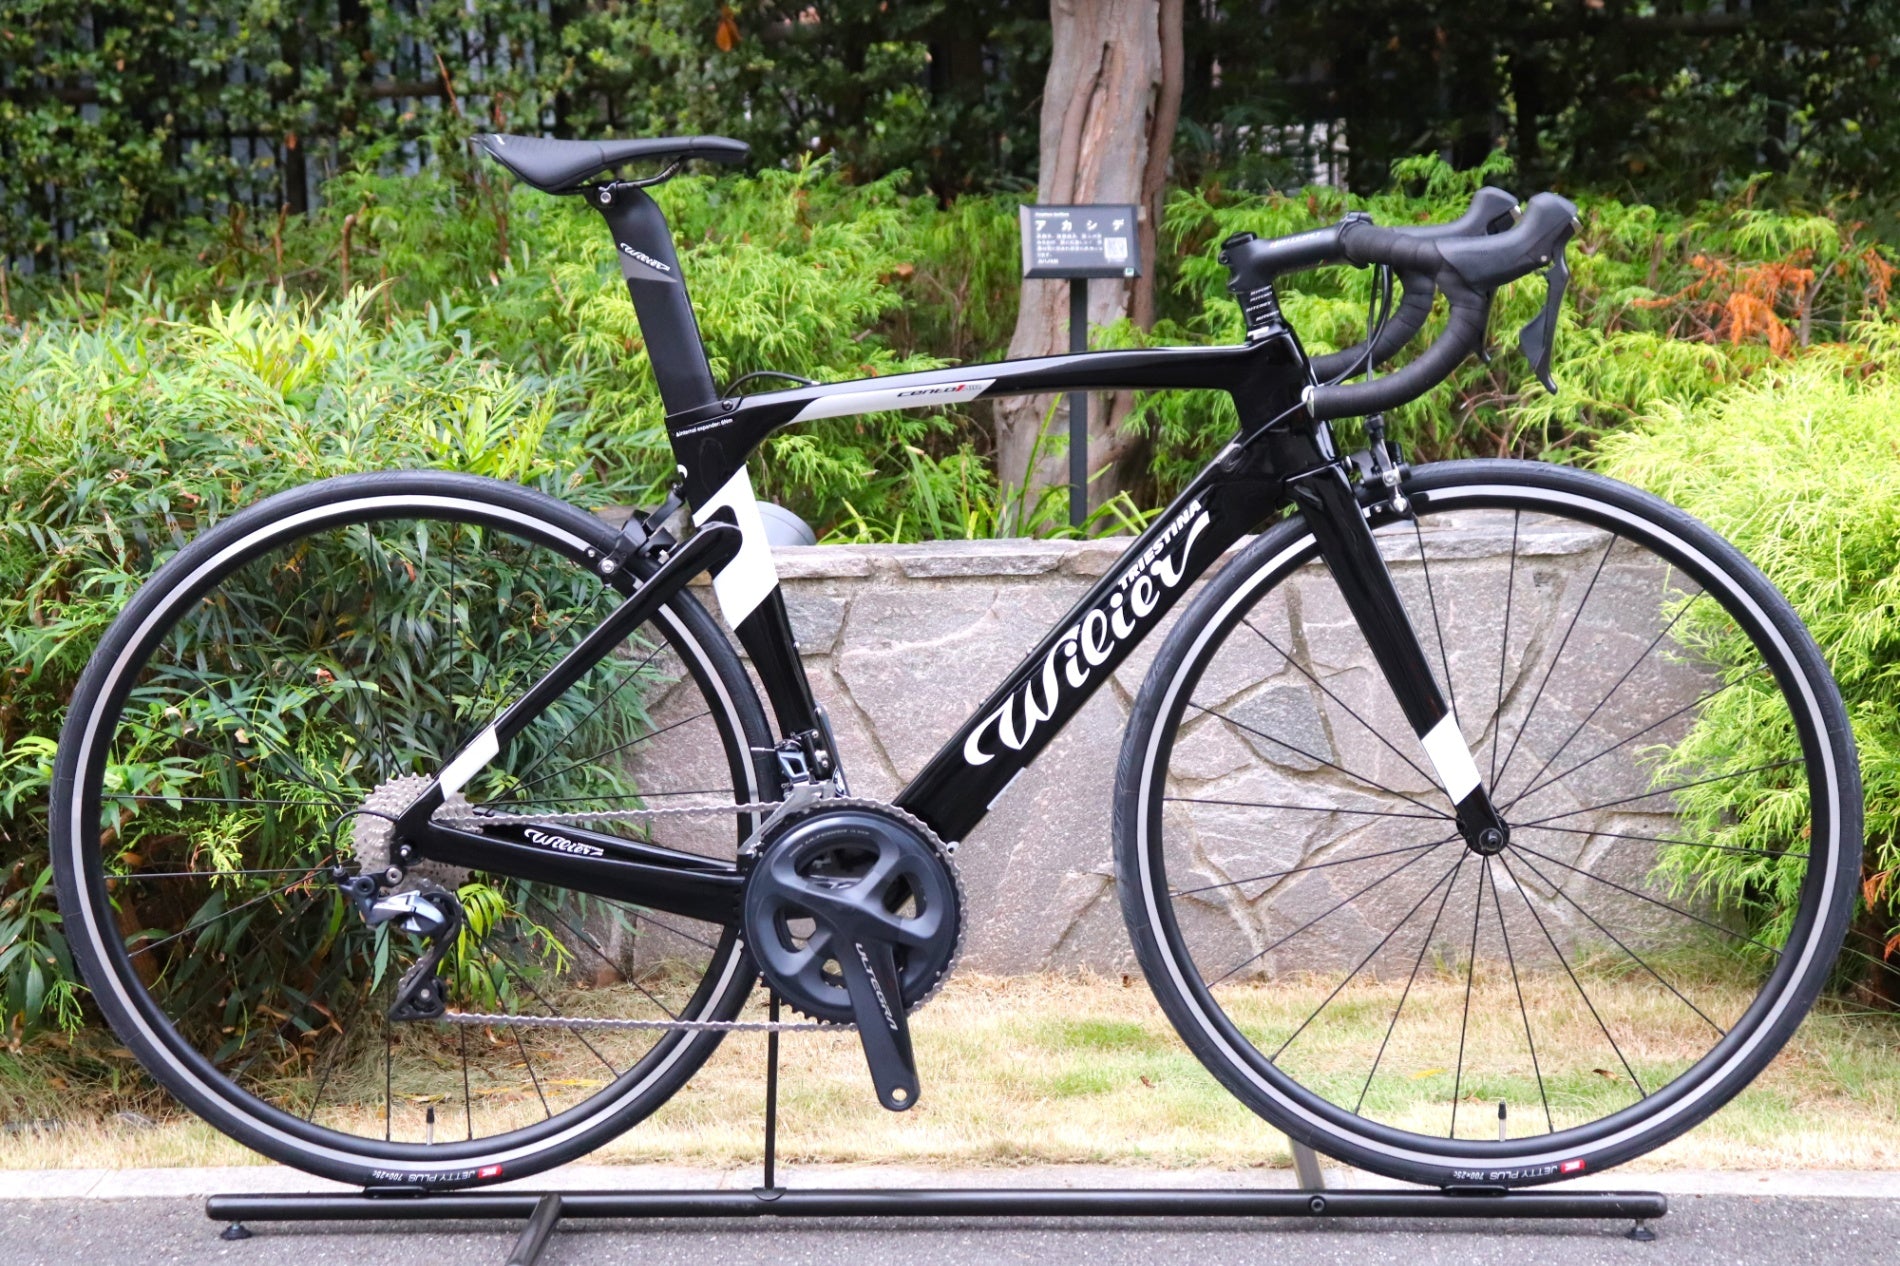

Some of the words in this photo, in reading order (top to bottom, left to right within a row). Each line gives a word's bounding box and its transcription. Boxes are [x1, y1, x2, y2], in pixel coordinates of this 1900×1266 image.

[1117, 499, 1202, 590] TRIESTINA
[963, 510, 1210, 766] Wilier
[523, 828, 604, 856] Wilier
[855, 942, 899, 1031] ULTEGRA
[408, 1172, 438, 1183] PLUS
[439, 1169, 476, 1182] JETTY
[1489, 1170, 1519, 1180] PLUS
[1521, 1165, 1558, 1178] JETTY
